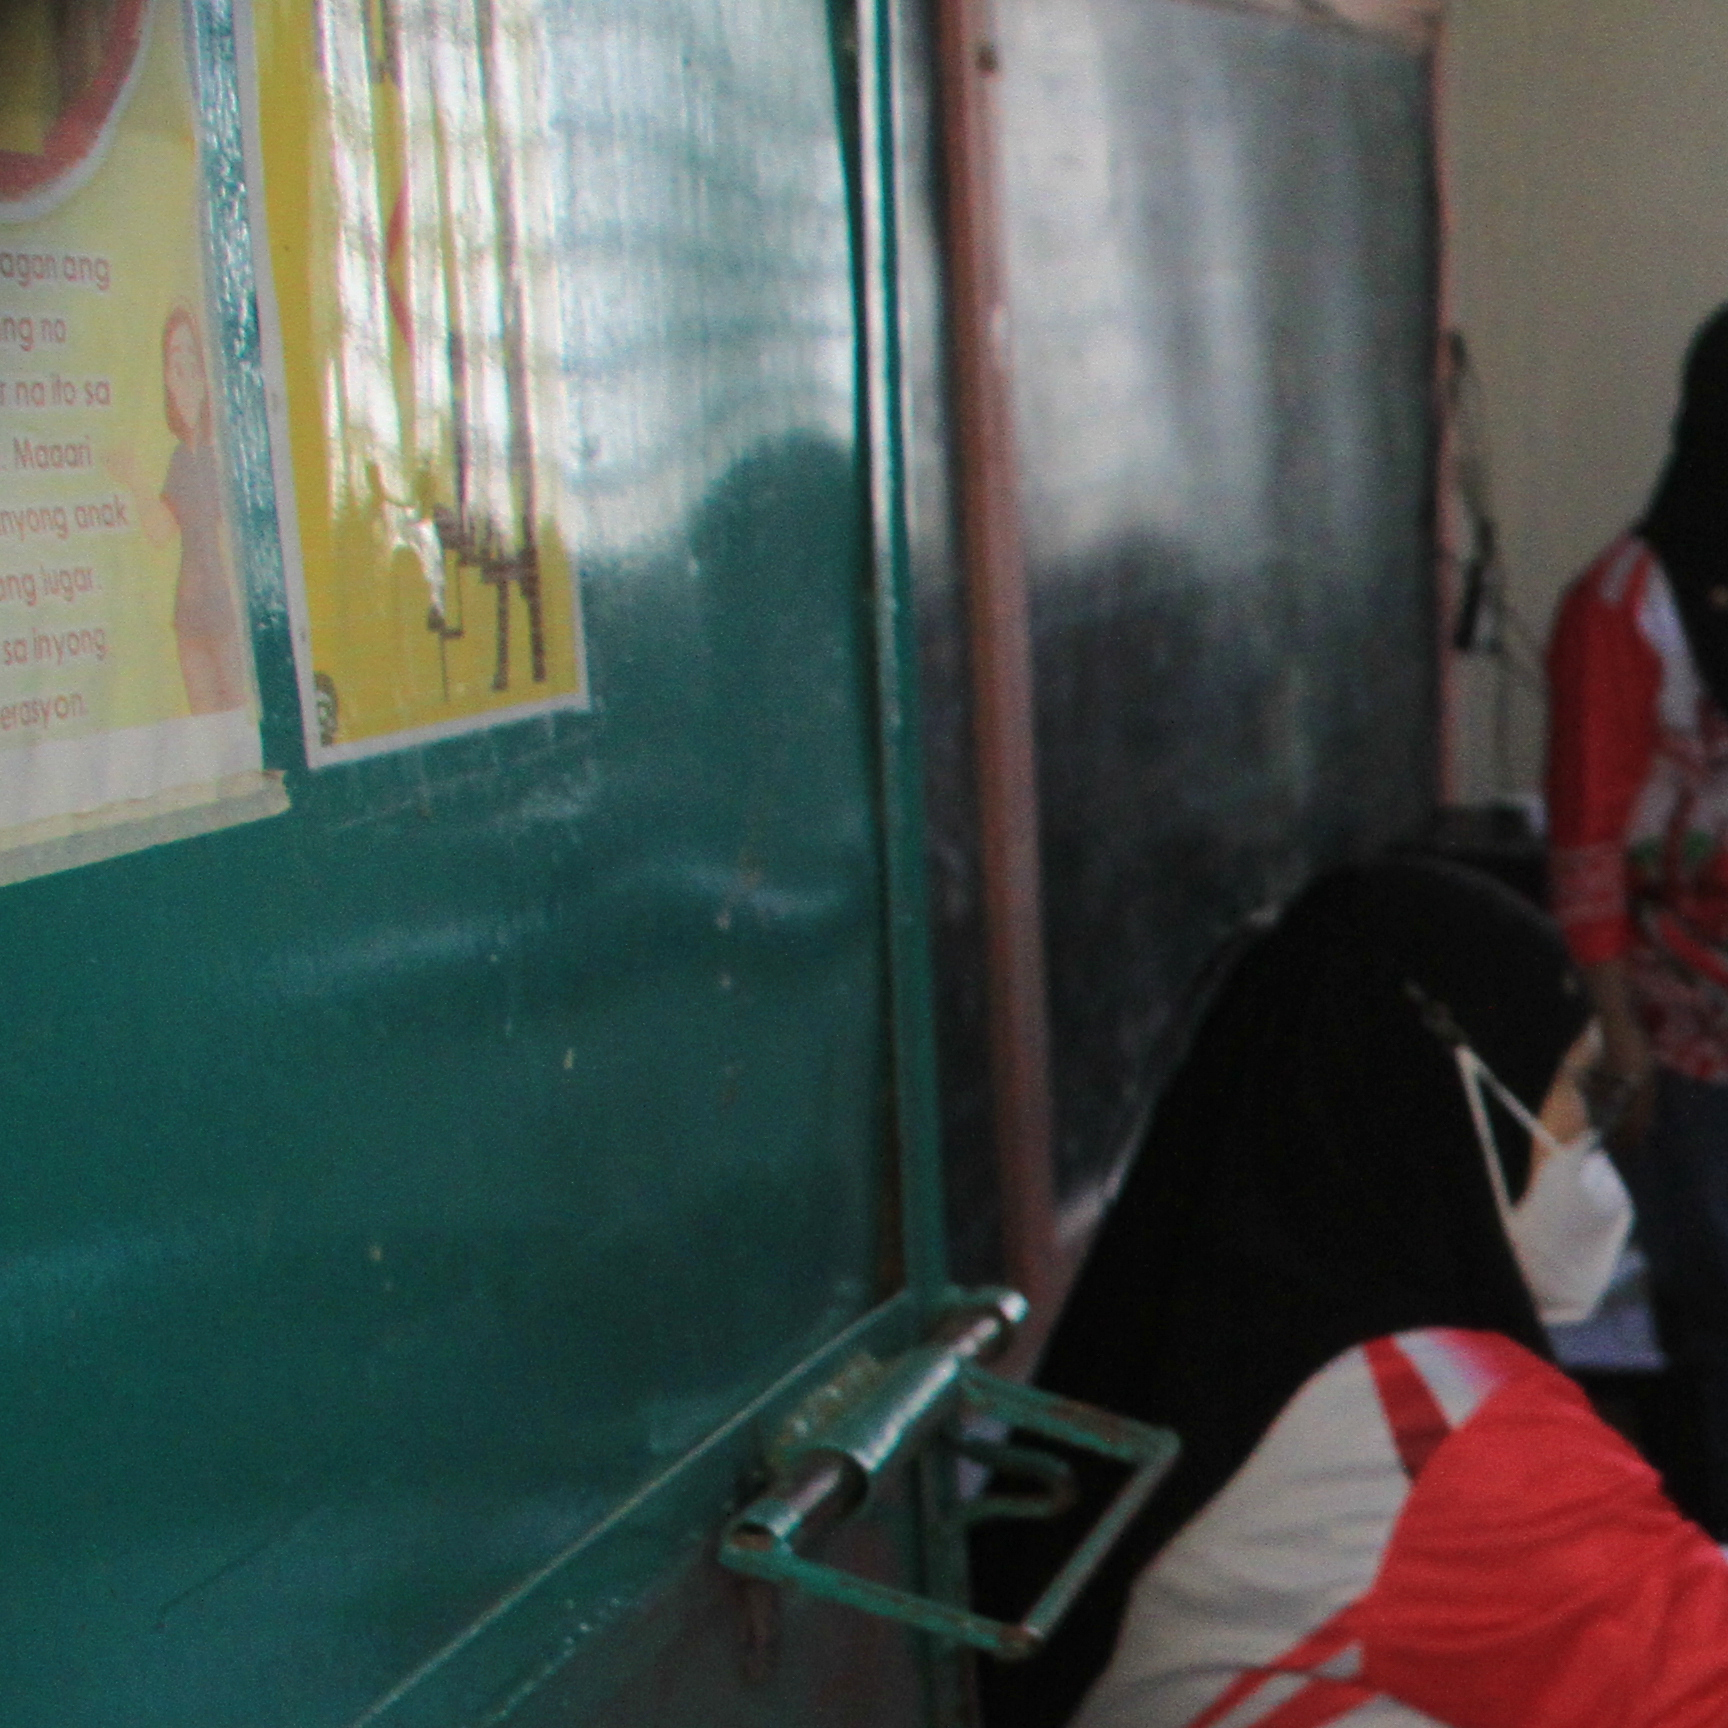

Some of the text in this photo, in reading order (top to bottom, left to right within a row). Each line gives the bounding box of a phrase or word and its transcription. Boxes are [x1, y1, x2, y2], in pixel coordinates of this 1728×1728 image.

[63, 256, 111, 291] ang
[41, 318, 67, 343] na
[16, 382, 45, 407] na
[51, 373, 76, 406] ito
[84, 381, 112, 406] sa
[13, 435, 93, 469] Maaari
[75, 495, 129, 530] anak
[3, 627, 108, 666] sa inyong
